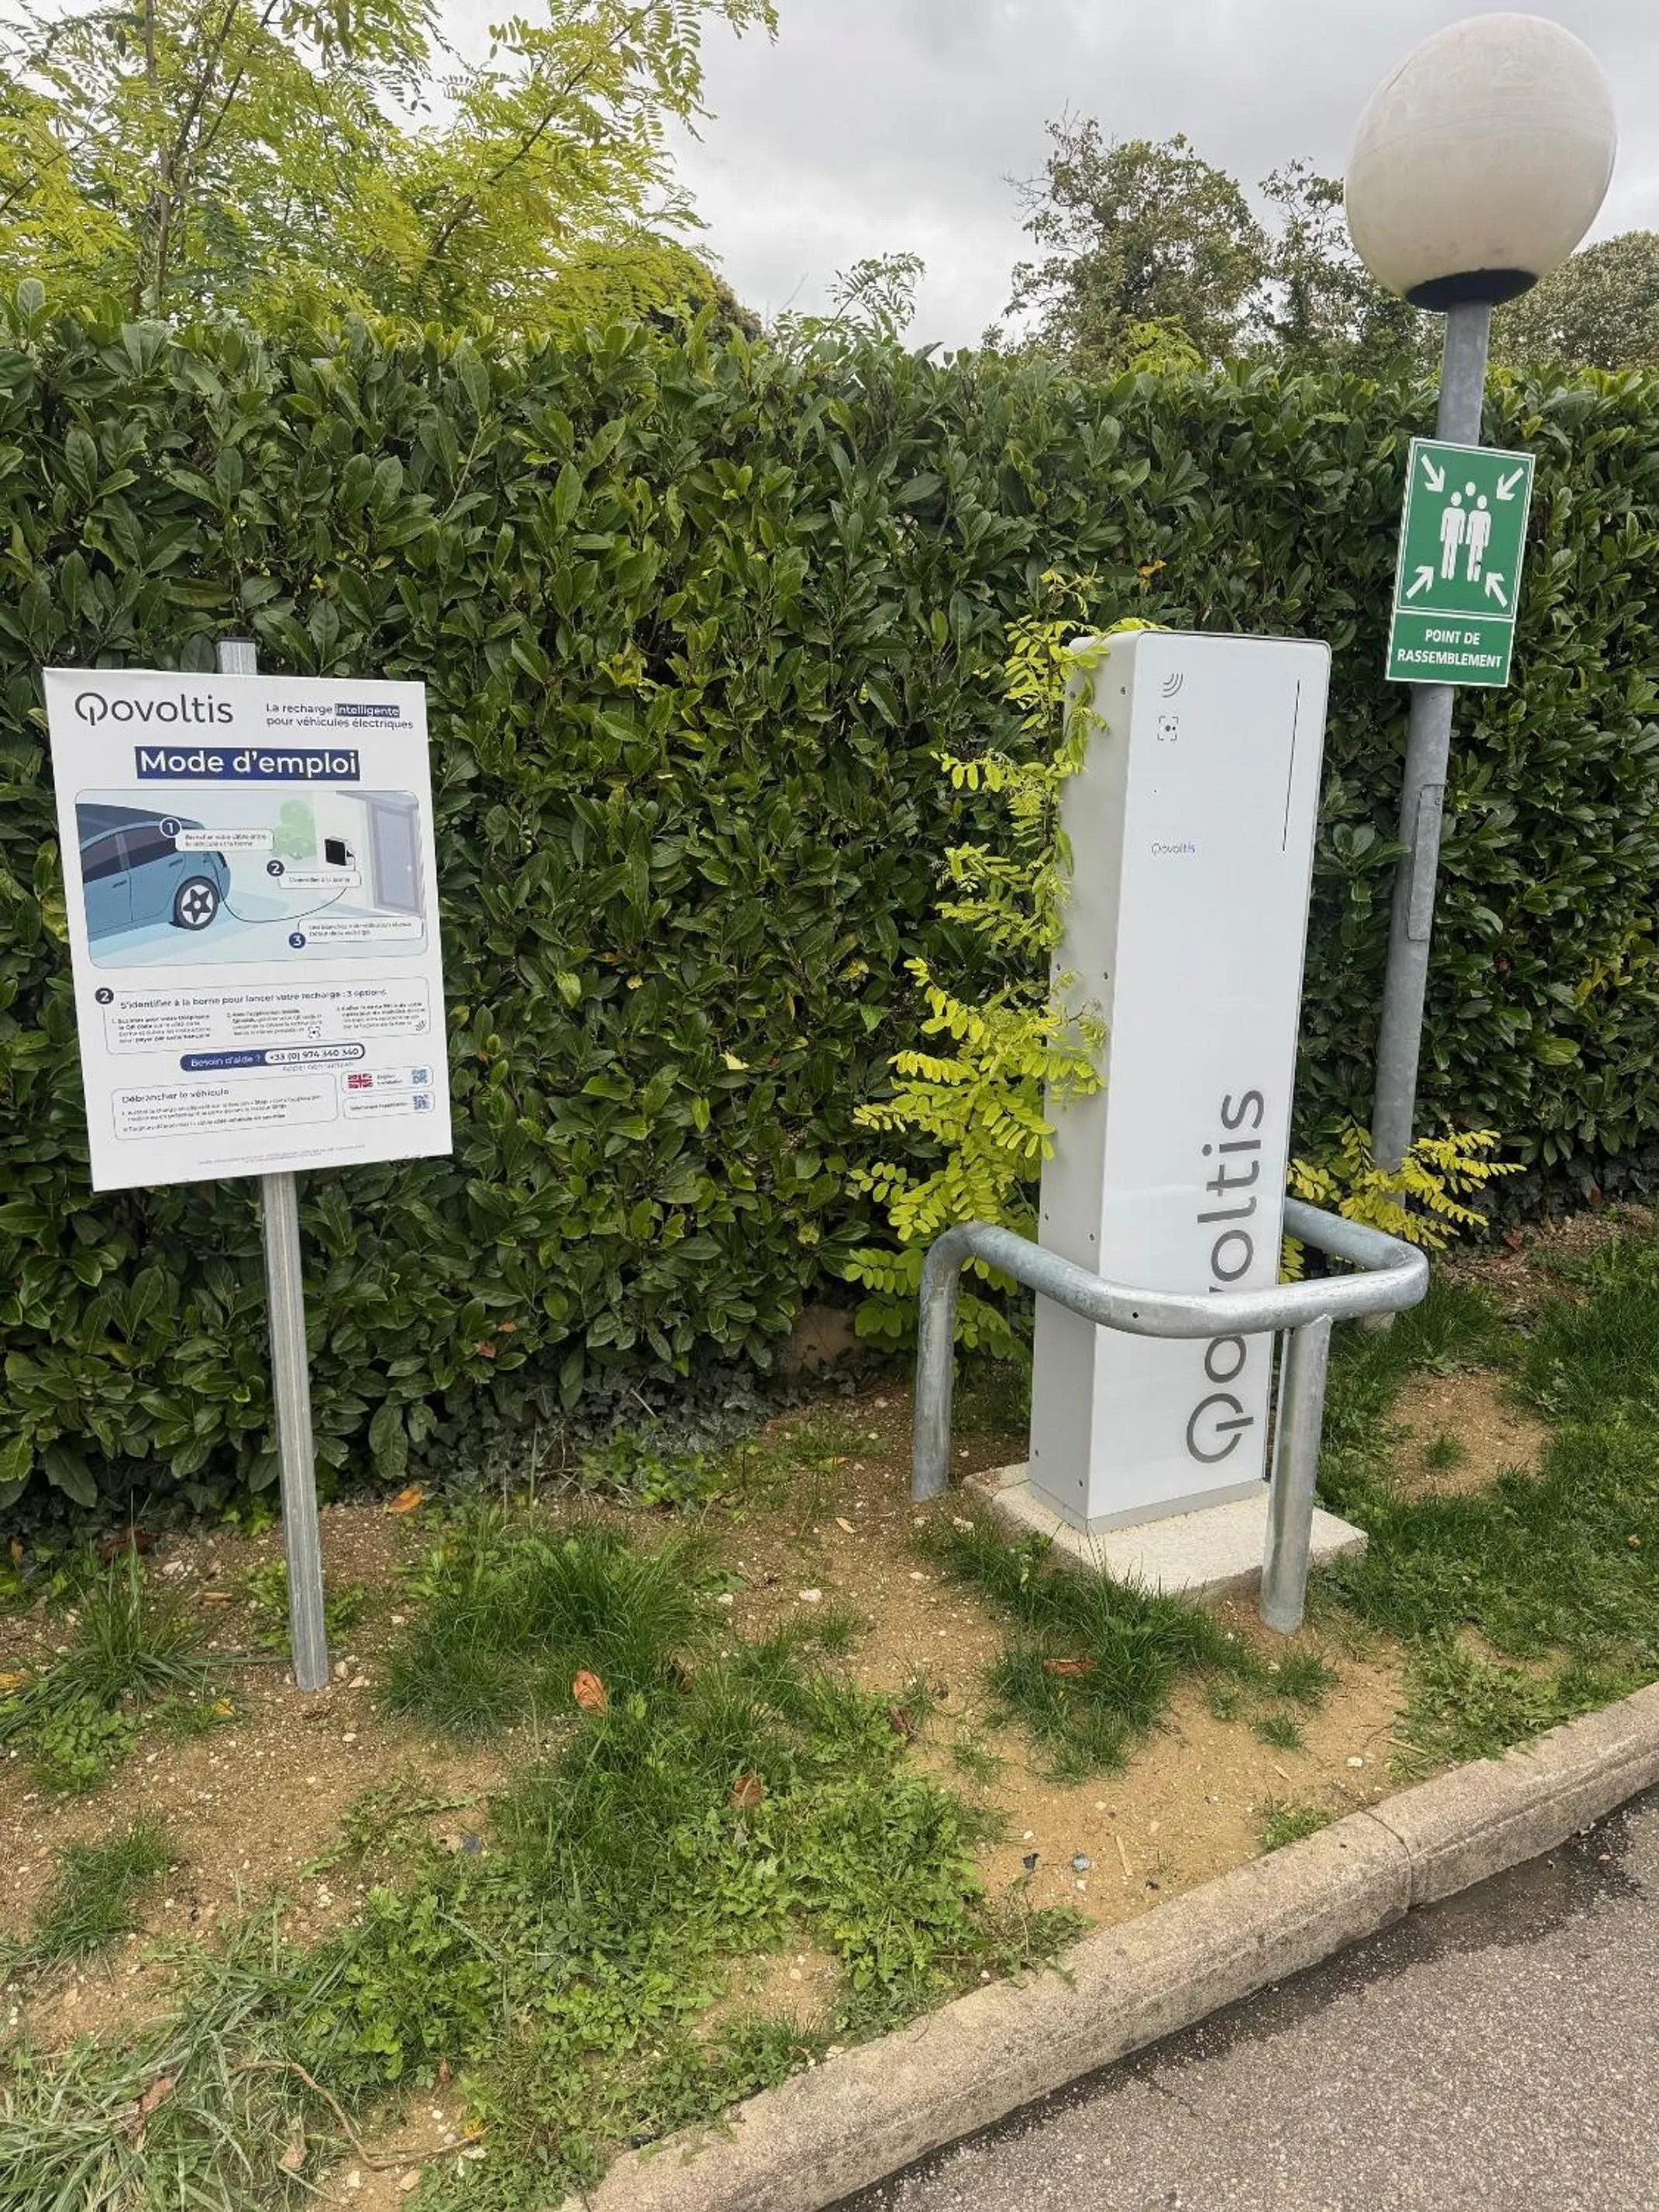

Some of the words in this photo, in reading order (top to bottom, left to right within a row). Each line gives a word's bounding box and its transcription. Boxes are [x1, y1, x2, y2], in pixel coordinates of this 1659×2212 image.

[1425, 629, 1462, 644] POINT
[1464, 632, 1481, 645] DE
[1397, 648, 1503, 668] RASSEMBLEMENT
[75, 692, 234, 726] Qovoltis
[266, 702, 280, 713] La
[282, 703, 333, 716] recharge
[335, 703, 400, 717] intelligente
[266, 717, 293, 728] pour
[296, 717, 349, 728] véhicules
[352, 718, 414, 730] électriques
[141, 750, 225, 773] Mode
[232, 750, 356, 778] d'emploi
[167, 822, 173, 834] 1
[271, 863, 281, 874] 2
[292, 935, 302, 946] 3
[99, 990, 110, 1002] 2
[193, 997, 221, 1005] borne
[222, 996, 243, 1005] pour
[246, 994, 274, 1003] lancer
[302, 991, 341, 999] recharge
[191, 1058, 224, 1067] Besoin
[190, 1087, 229, 1098] véhicule
[1187, 1090, 1265, 1464] Qooltis
